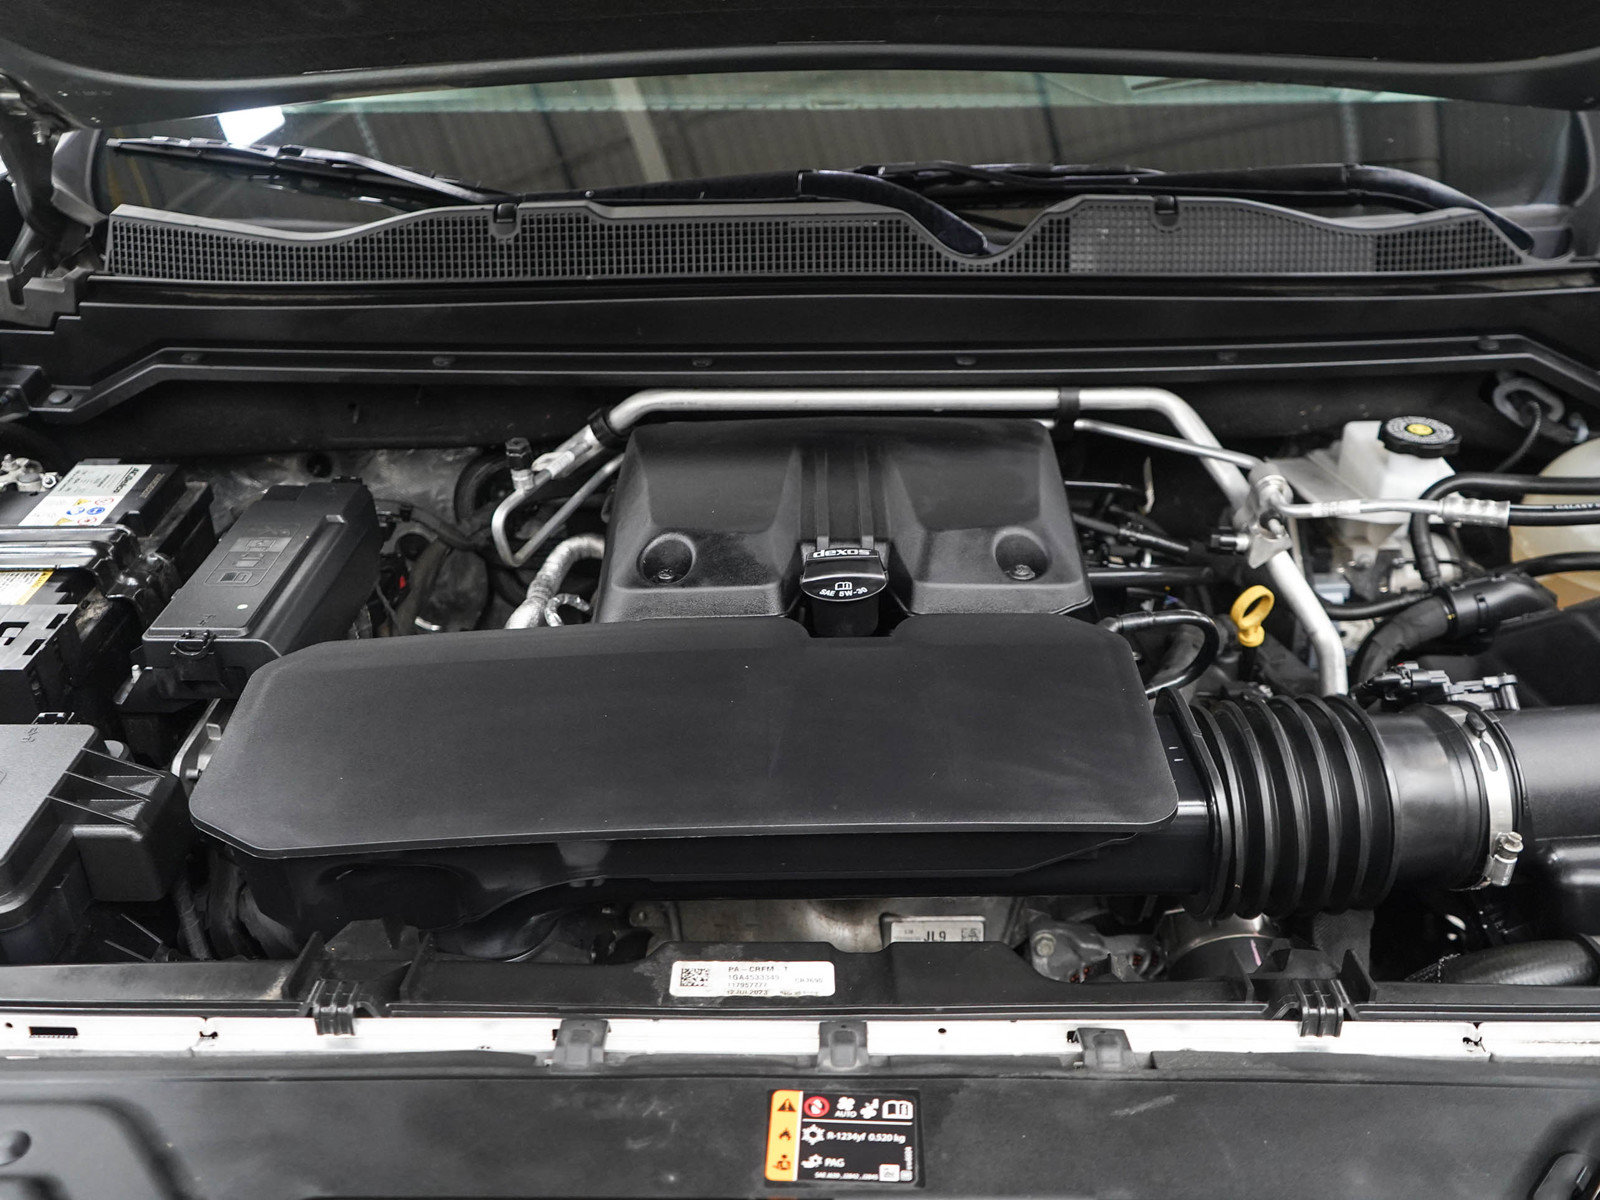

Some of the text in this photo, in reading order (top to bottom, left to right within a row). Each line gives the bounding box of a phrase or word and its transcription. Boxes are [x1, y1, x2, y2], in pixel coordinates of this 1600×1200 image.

[813, 549, 872, 558] dexos
[819, 586, 868, 597] SAE 5W-30
[924, 930, 947, 942] JL9
[834, 1110, 858, 1118] AUTO
[826, 1131, 906, 1145] R-1234yf 0.520 kg
[824, 1157, 846, 1168] PAG
